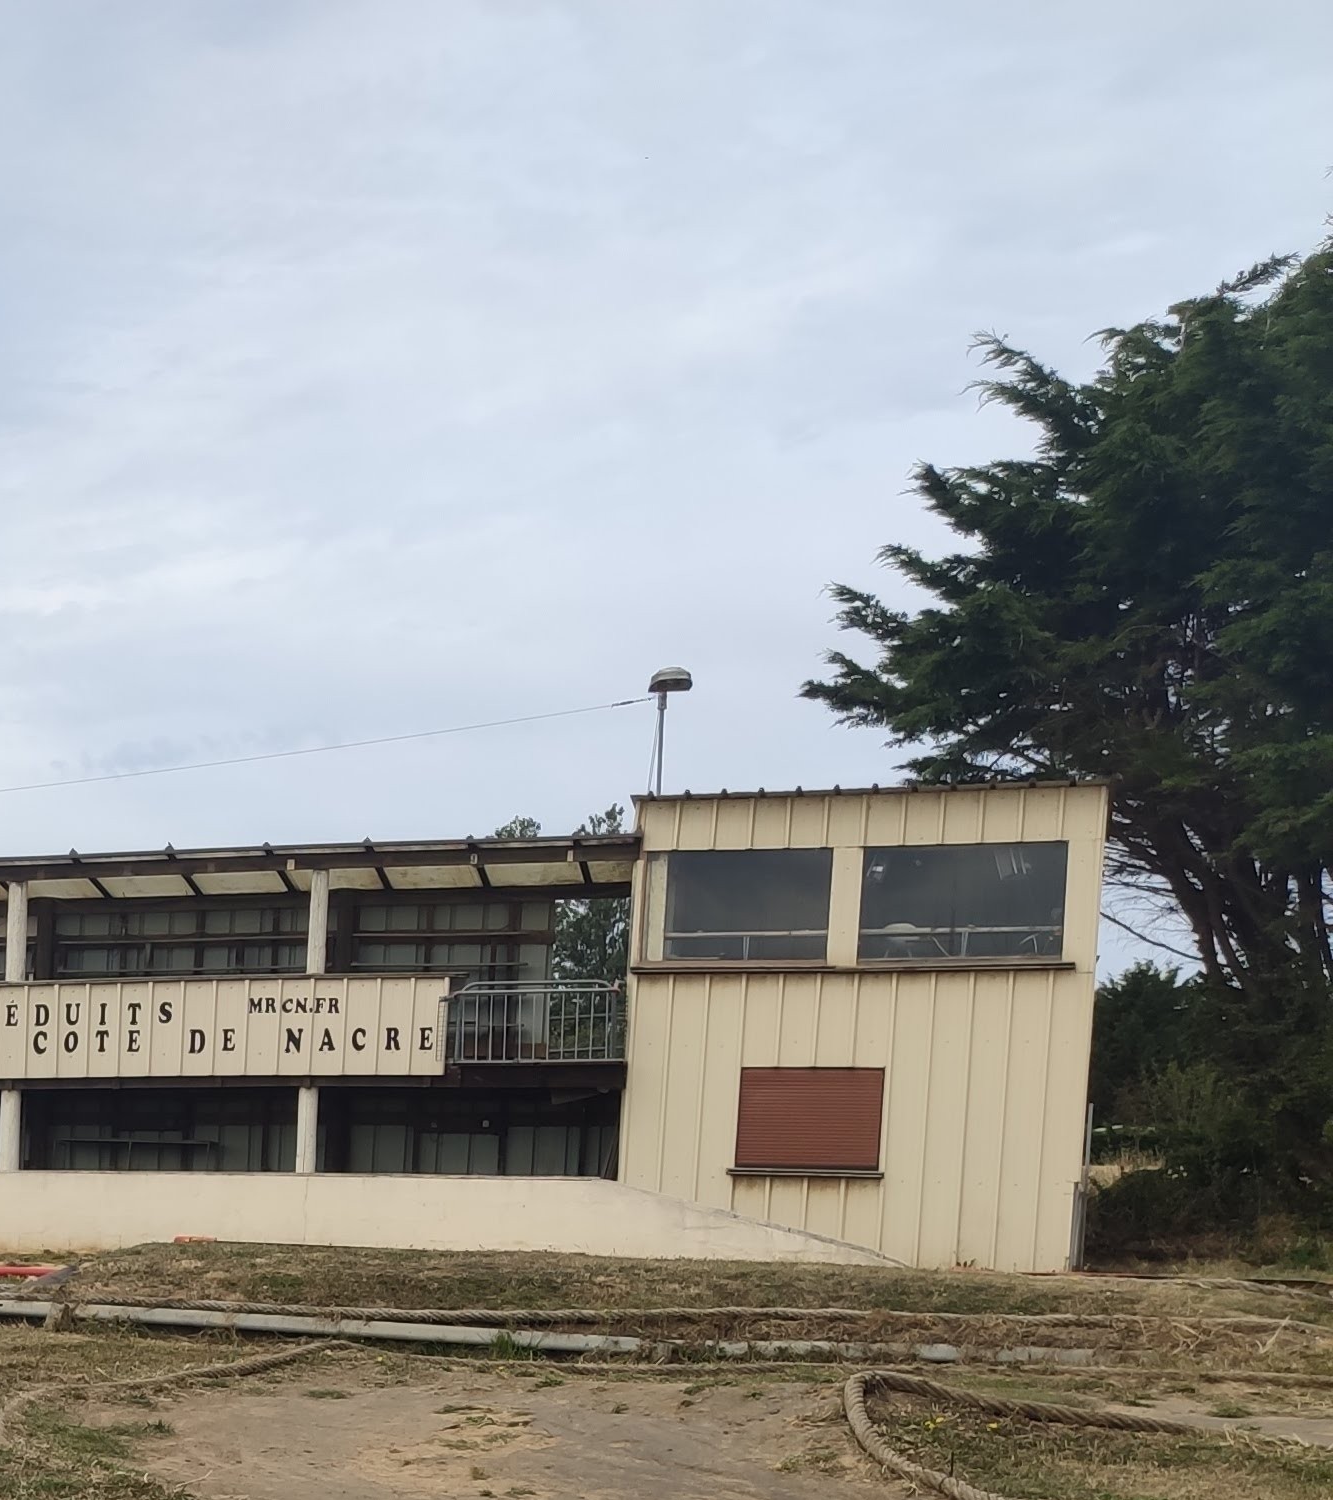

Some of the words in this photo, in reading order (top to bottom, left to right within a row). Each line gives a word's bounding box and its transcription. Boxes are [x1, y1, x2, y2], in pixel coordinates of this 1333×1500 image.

[248, 996, 340, 1014] MRCN.FR
[32, 1029, 141, 1055] COTE
[187, 1027, 237, 1054] DE
[284, 1026, 434, 1054] NACRE
